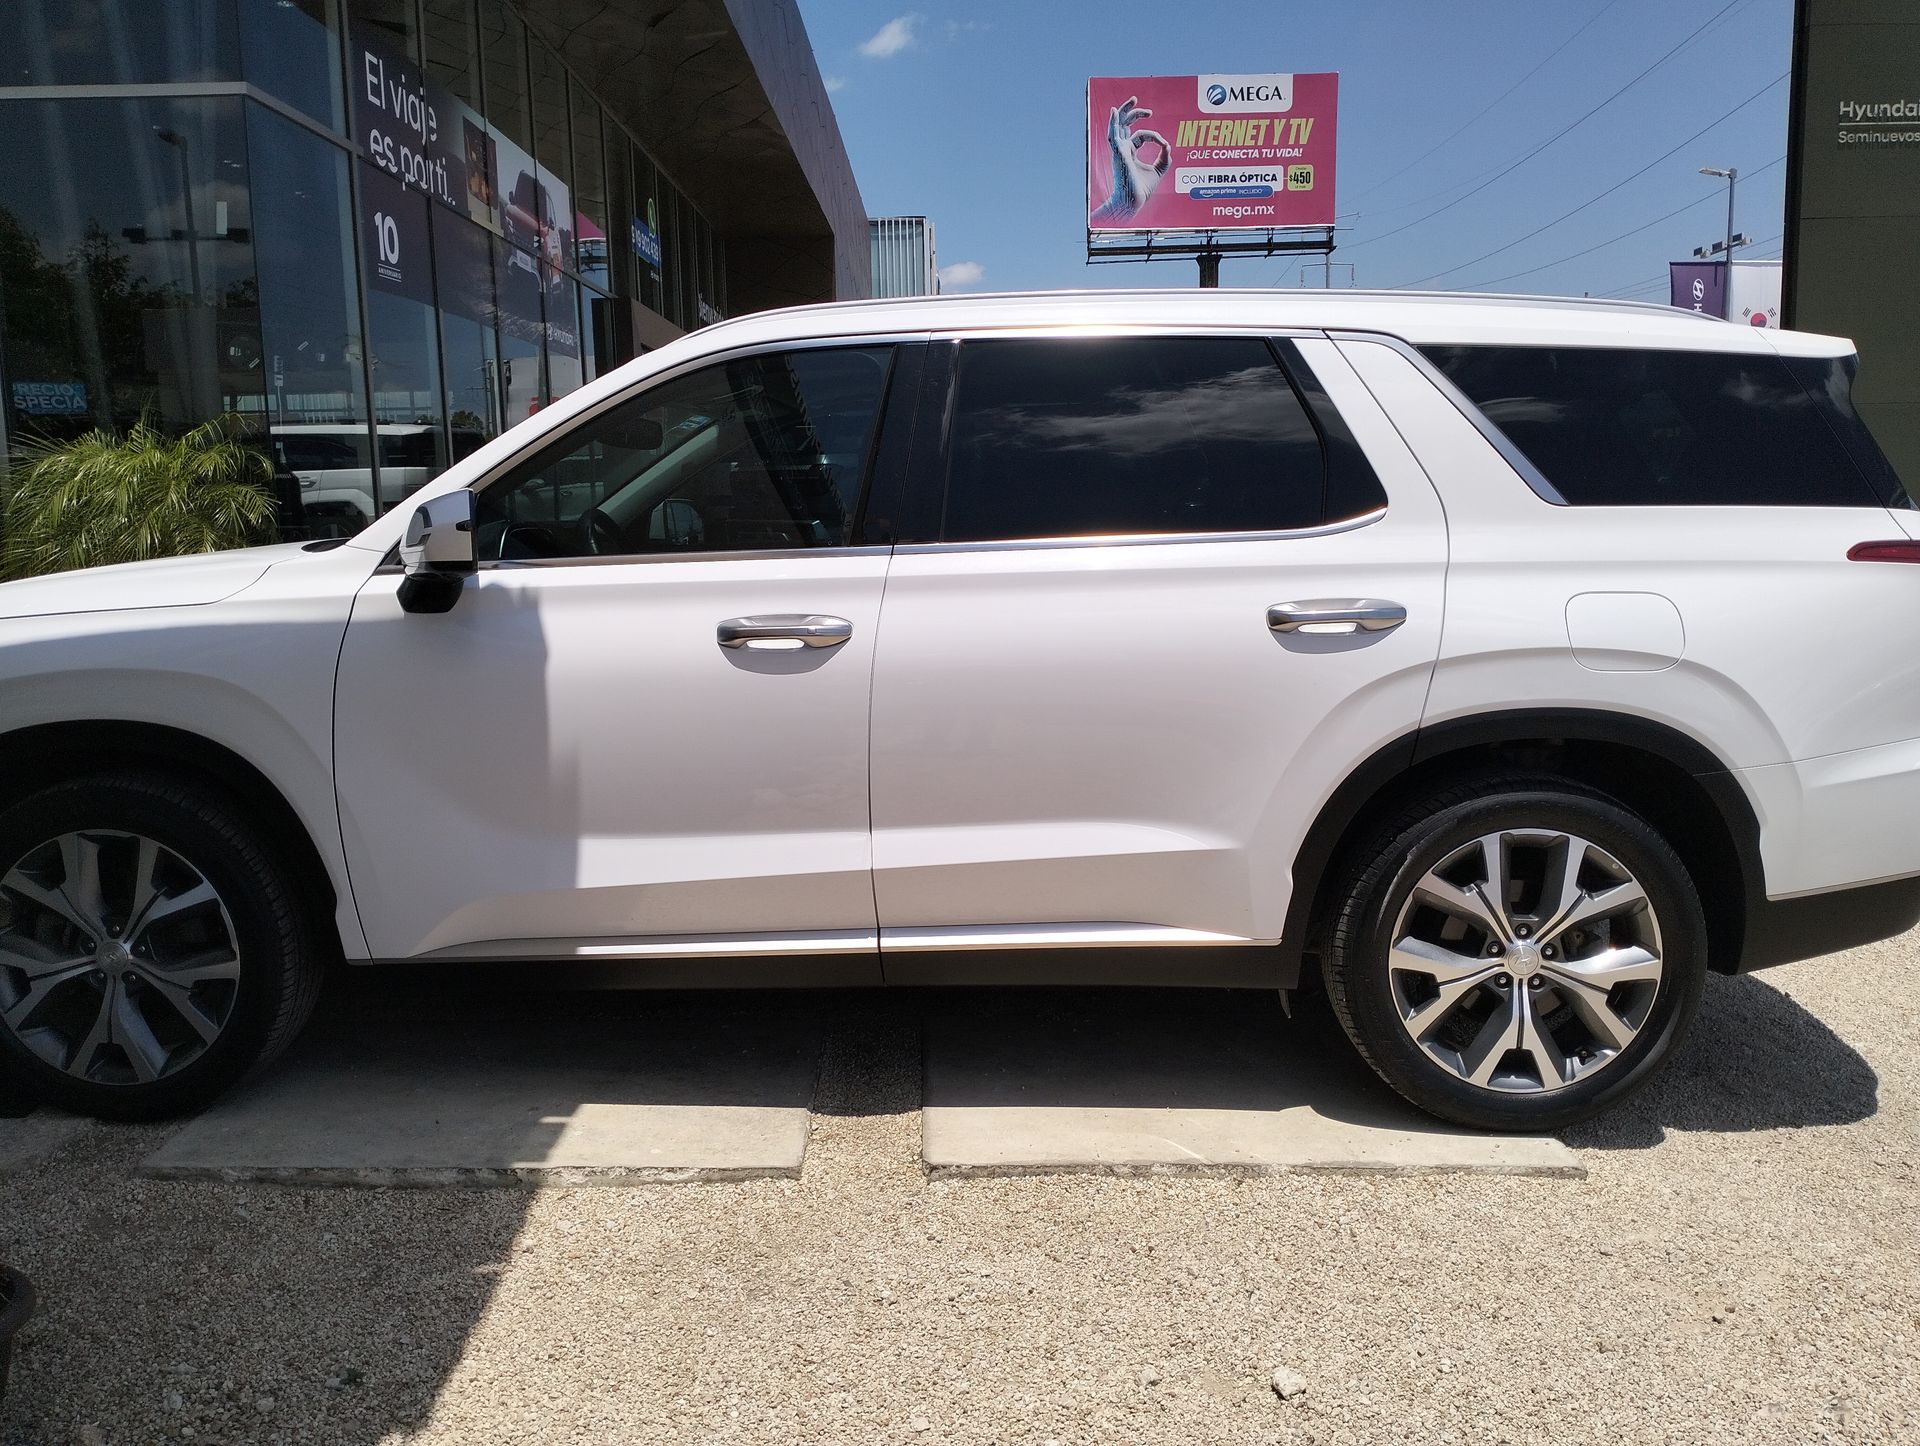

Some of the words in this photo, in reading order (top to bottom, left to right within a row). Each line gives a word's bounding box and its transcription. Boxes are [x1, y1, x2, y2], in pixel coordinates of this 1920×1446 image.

[365, 51, 386, 110] El
[389, 74, 437, 145] viaje
[1229, 86, 1282, 101] MEGA
[1175, 119, 1269, 147] INTERNET
[1273, 118, 1286, 146] Y
[1288, 117, 1315, 145] TV
[1838, 131, 1920, 143] Seminuevos
[370, 128, 398, 173] es
[1186, 150, 1212, 161] ¡QUE
[1213, 149, 1260, 159] CONECTA
[1262, 149, 1275, 158] TU
[1276, 148, 1303, 157] VIDA!
[1182, 175, 1205, 184] CON
[1208, 174, 1237, 184] FIBRA
[1239, 171, 1278, 183] ÓPTICA
[1289, 171, 1311, 184] $450
[1213, 205, 1275, 218] mega.mx
[374, 212, 399, 264] 10
